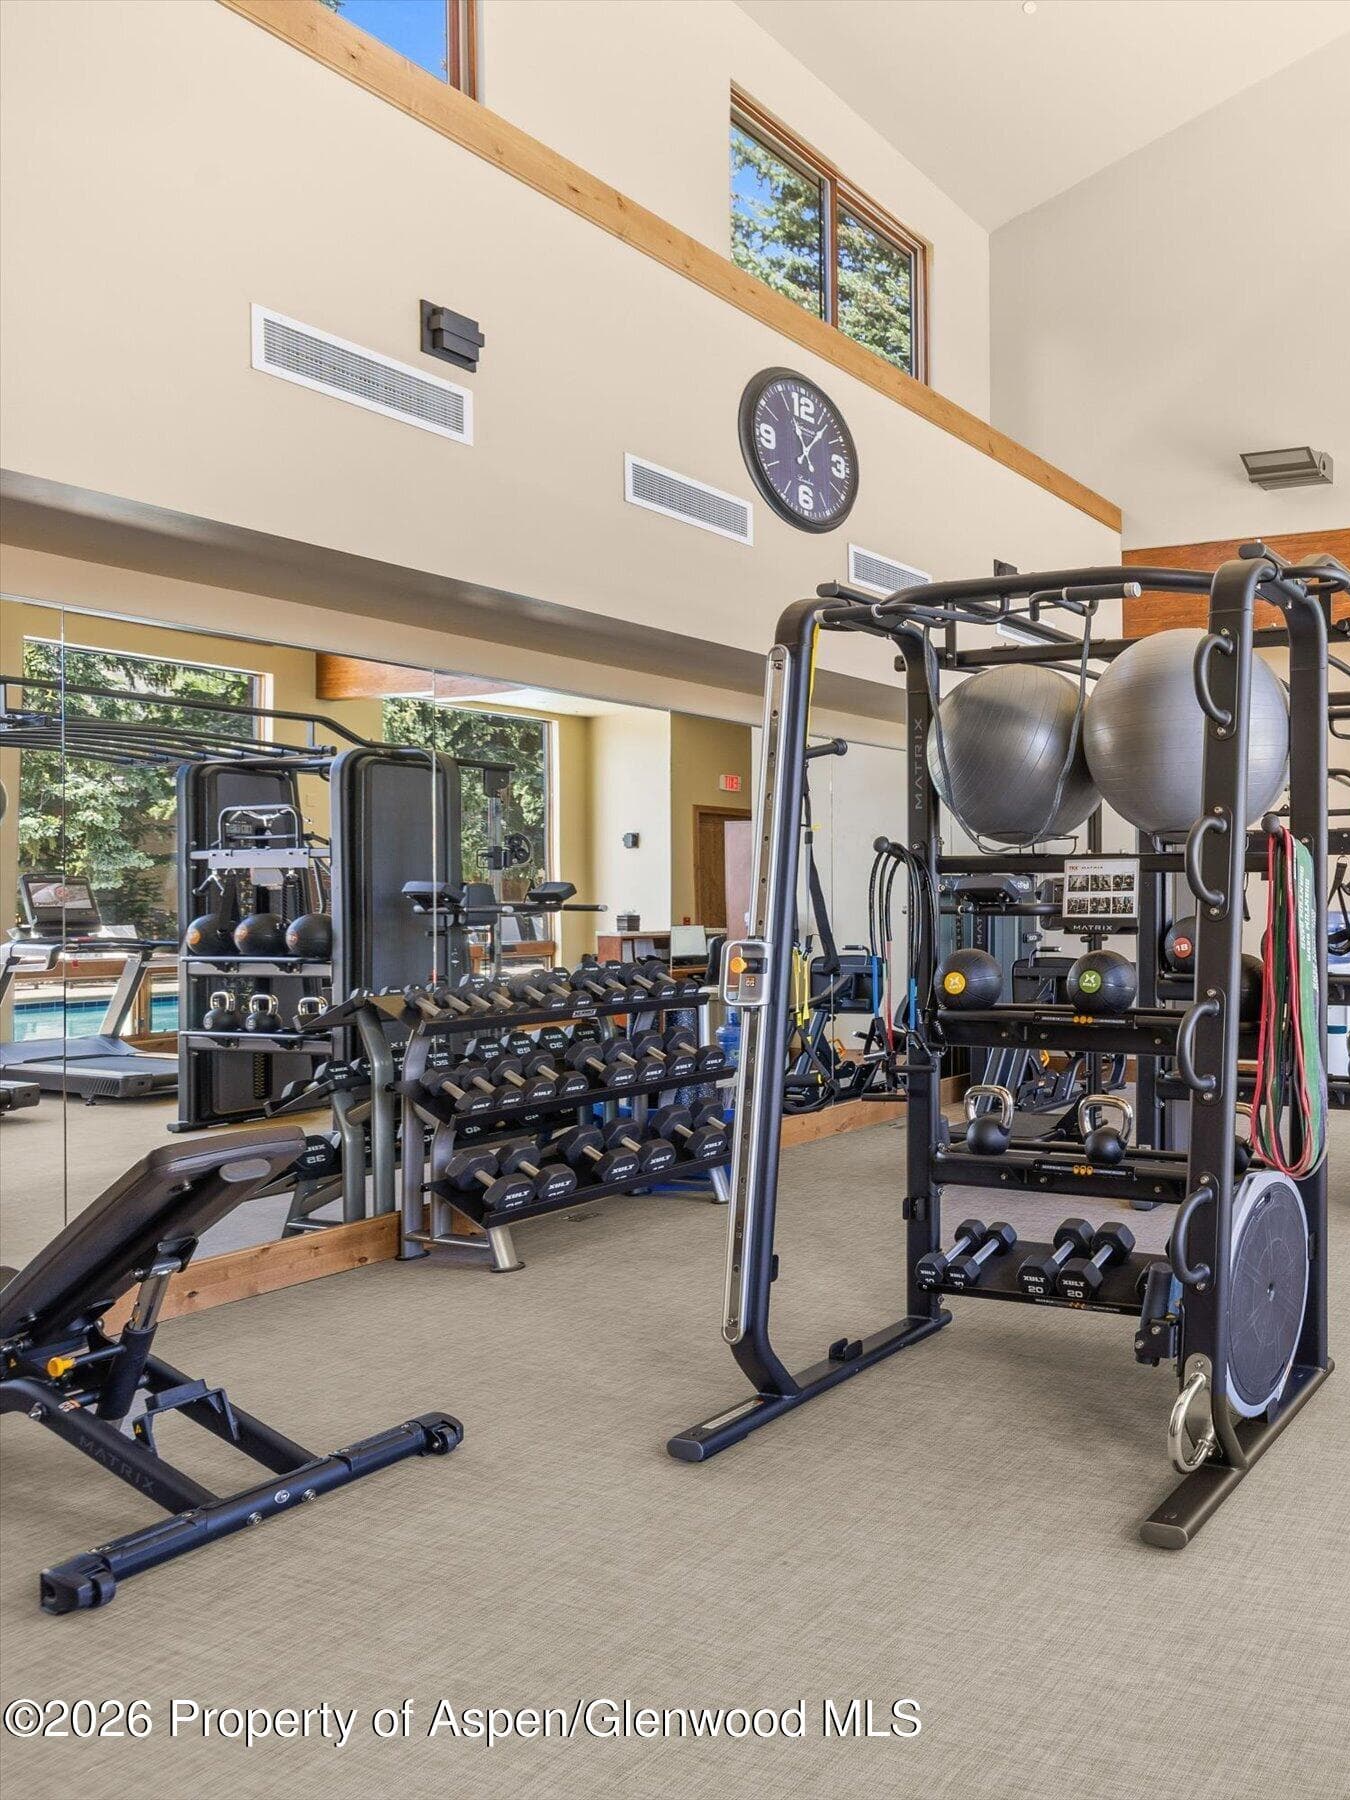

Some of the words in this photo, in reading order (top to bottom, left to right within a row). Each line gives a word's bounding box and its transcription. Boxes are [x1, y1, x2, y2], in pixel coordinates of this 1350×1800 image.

[791, 391, 816, 424] 12
[759, 422, 776, 450] 9
[831, 453, 846, 480] 3
[798, 484, 814, 510] 6
[914, 718, 923, 810] MATRIX
[548, 1179, 573, 1190] XULT
[504, 1189, 531, 1201] XULT
[1023, 1275, 1046, 1283] XULT
[1062, 1279, 1085, 1287] XULT
[1027, 1285, 1045, 1294] 20
[1066, 1289, 1084, 1298] 20
[80, 1436, 155, 1489] MATRIX
